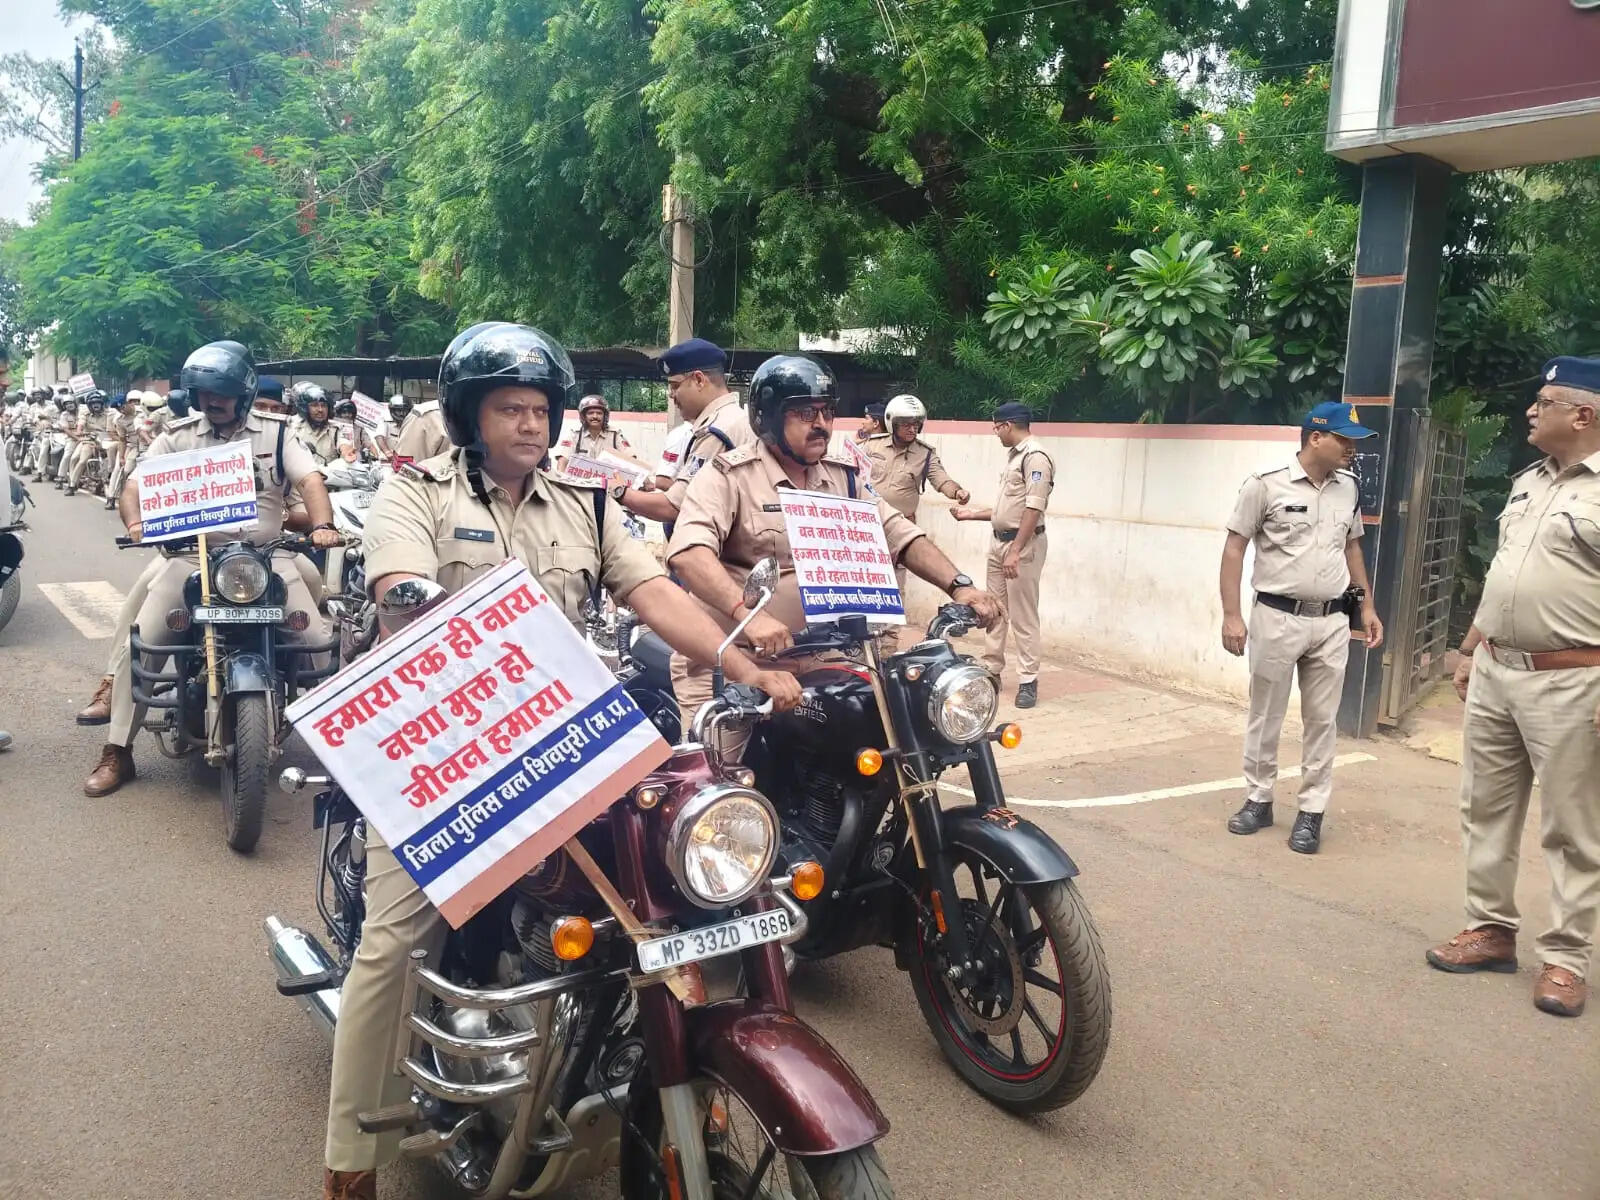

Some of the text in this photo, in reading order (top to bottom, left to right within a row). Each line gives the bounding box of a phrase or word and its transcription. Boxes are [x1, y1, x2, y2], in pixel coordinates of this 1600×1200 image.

[143, 469, 184, 487] साक्षरता
[185, 466, 201, 481] हम
[142, 475, 253, 511] नशे को जड़ से मिटायेंगे
[143, 520, 163, 534] जिला
[163, 516, 187, 532] पुलिस
[201, 506, 230, 522] शिवपुरी
[783, 504, 805, 517] नशा
[806, 501, 819, 518] जो
[819, 507, 844, 520] करता
[841, 503, 852, 522] है
[816, 527, 838, 541] जाता
[836, 524, 847, 543] है
[820, 549, 830, 561] न
[830, 546, 852, 563] रहती
[854, 547, 877, 563] उसकी
[804, 570, 815, 582] न
[815, 566, 827, 584] ही
[827, 571, 850, 584] रहता
[207, 609, 220, 618] UP
[256, 609, 281, 619] 3096
[312, 584, 548, 747] हमारा एक ही नारा,
[378, 641, 535, 761] नशा मुक्त हो
[401, 680, 574, 808] जीवन हमारा।
[402, 689, 639, 871] जिला पुलिस बल शिवपुरी (म.प्र.)
[661, 913, 788, 964] MP 33ZD 1868
